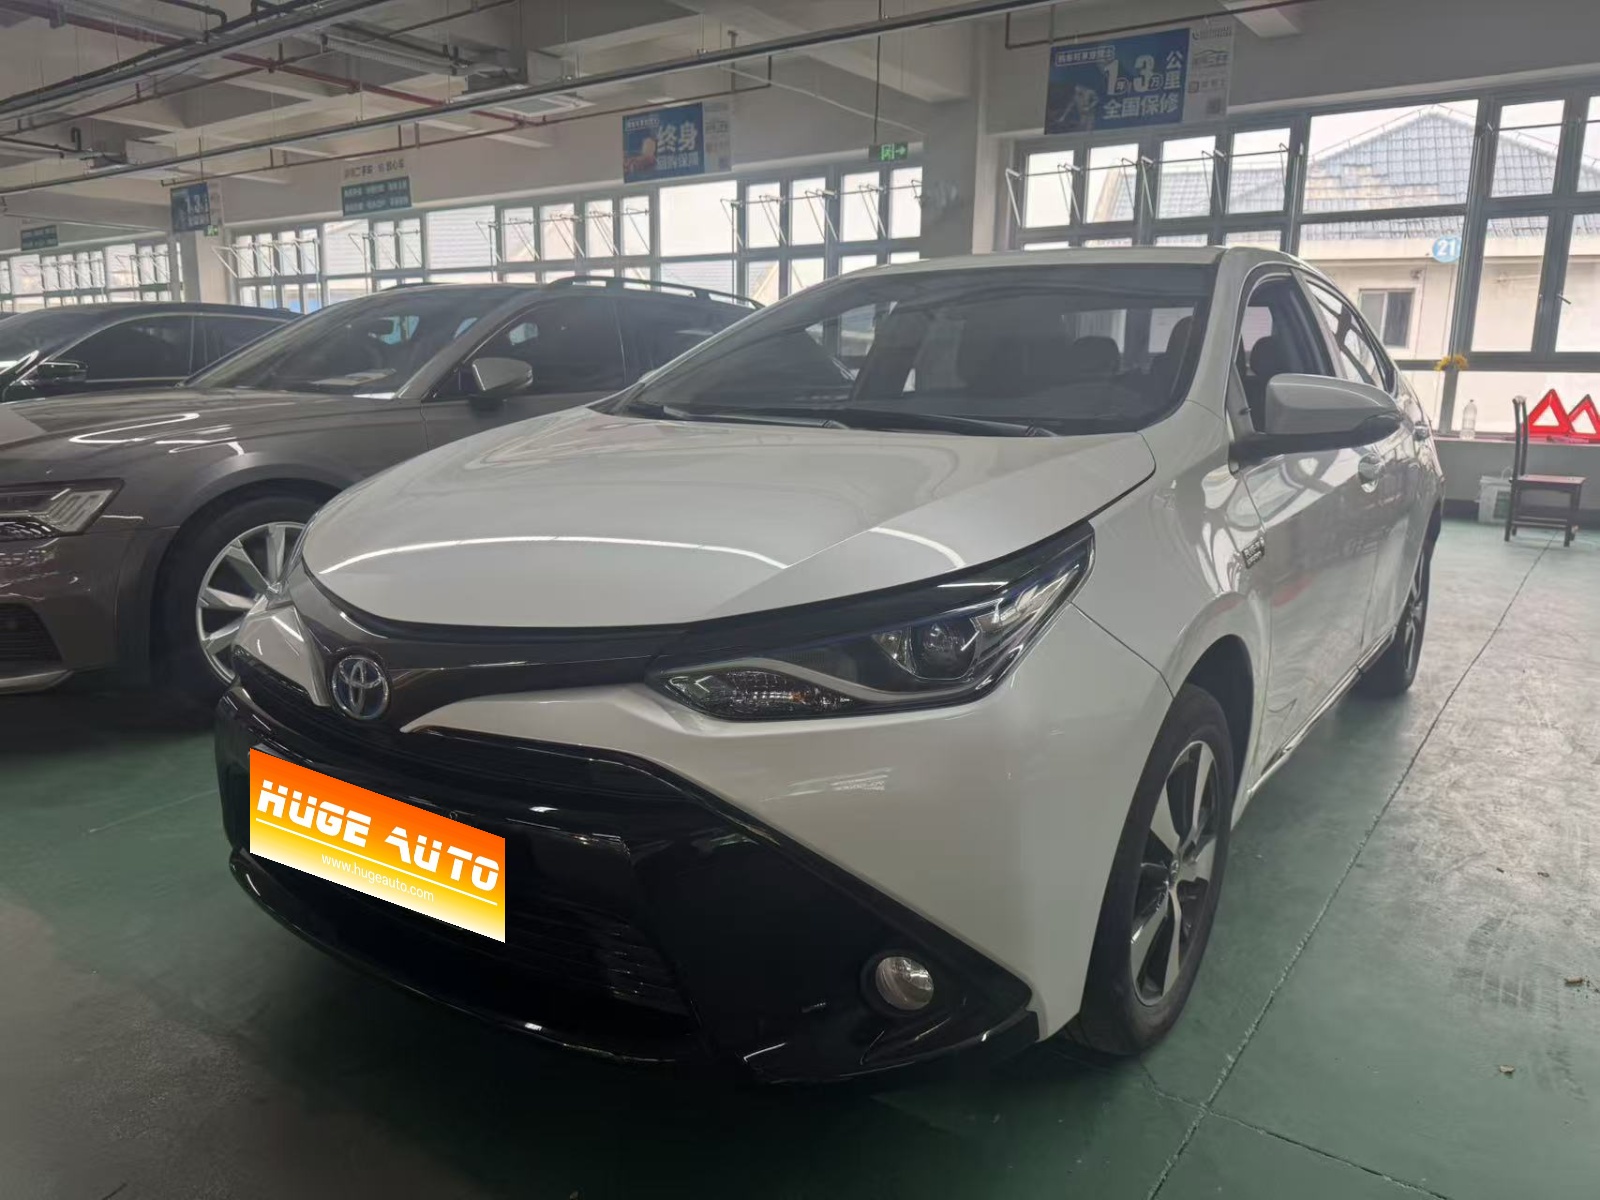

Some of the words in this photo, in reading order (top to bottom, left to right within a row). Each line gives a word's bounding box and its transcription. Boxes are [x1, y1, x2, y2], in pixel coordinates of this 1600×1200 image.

[1103, 93, 1179, 119] 全国保修
[657, 122, 698, 152] 终身
[1438, 239, 1455, 256] 21
